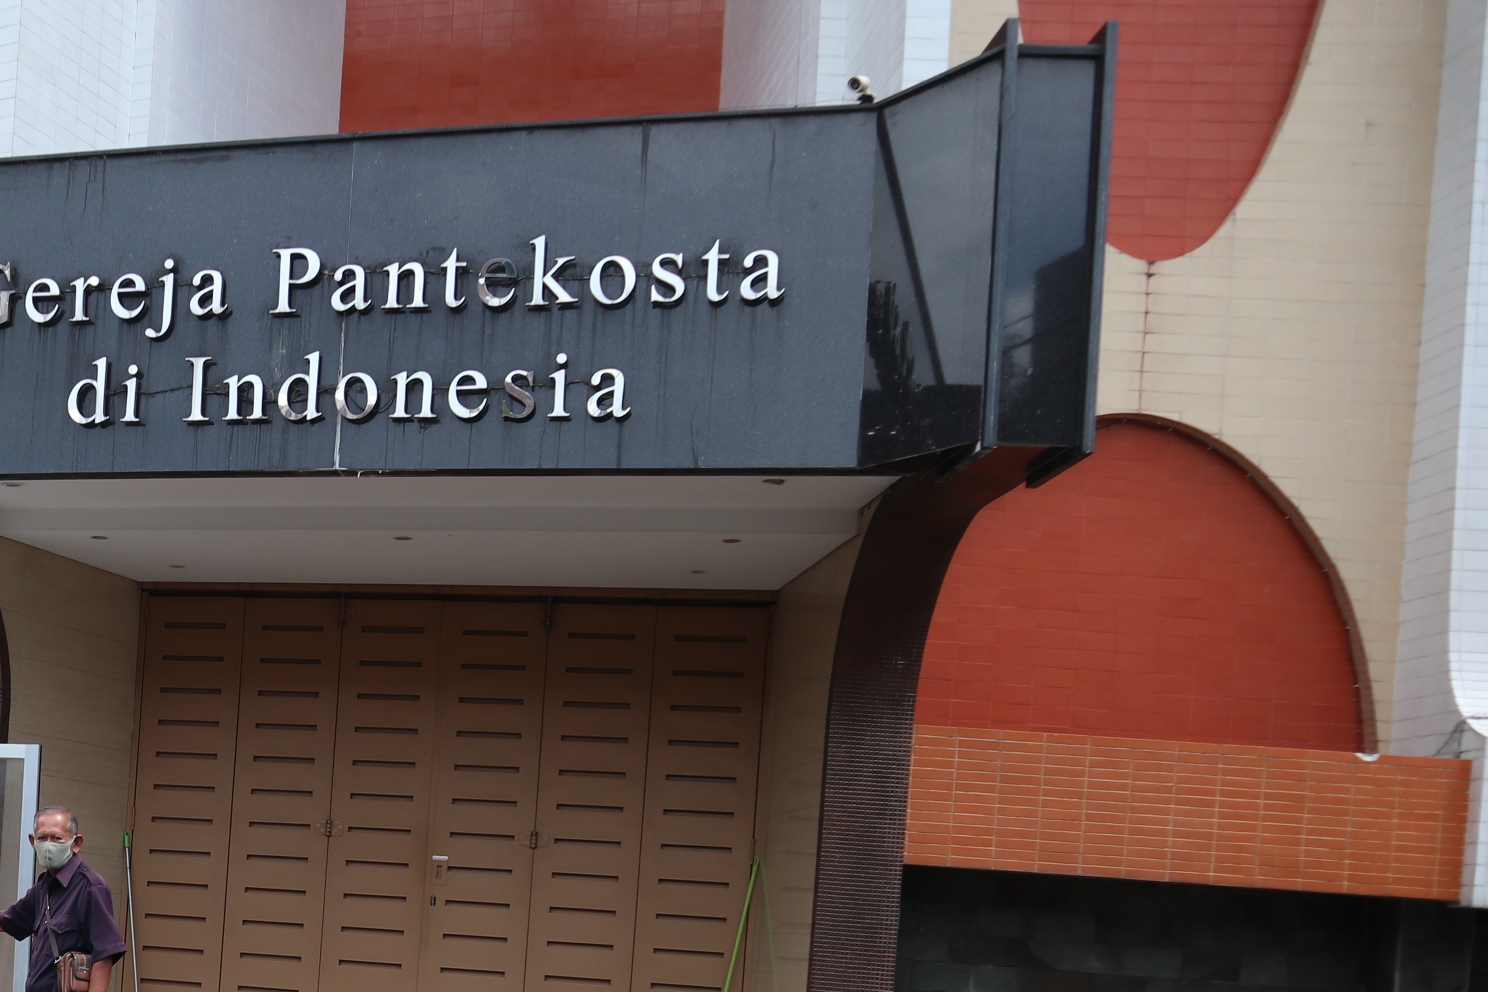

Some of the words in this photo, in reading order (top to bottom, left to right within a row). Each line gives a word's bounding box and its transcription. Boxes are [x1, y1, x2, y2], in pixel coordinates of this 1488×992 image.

[269, 235, 787, 316] Pantekosta
[67, 356, 141, 426] di
[183, 350, 631, 424] Indonesia
